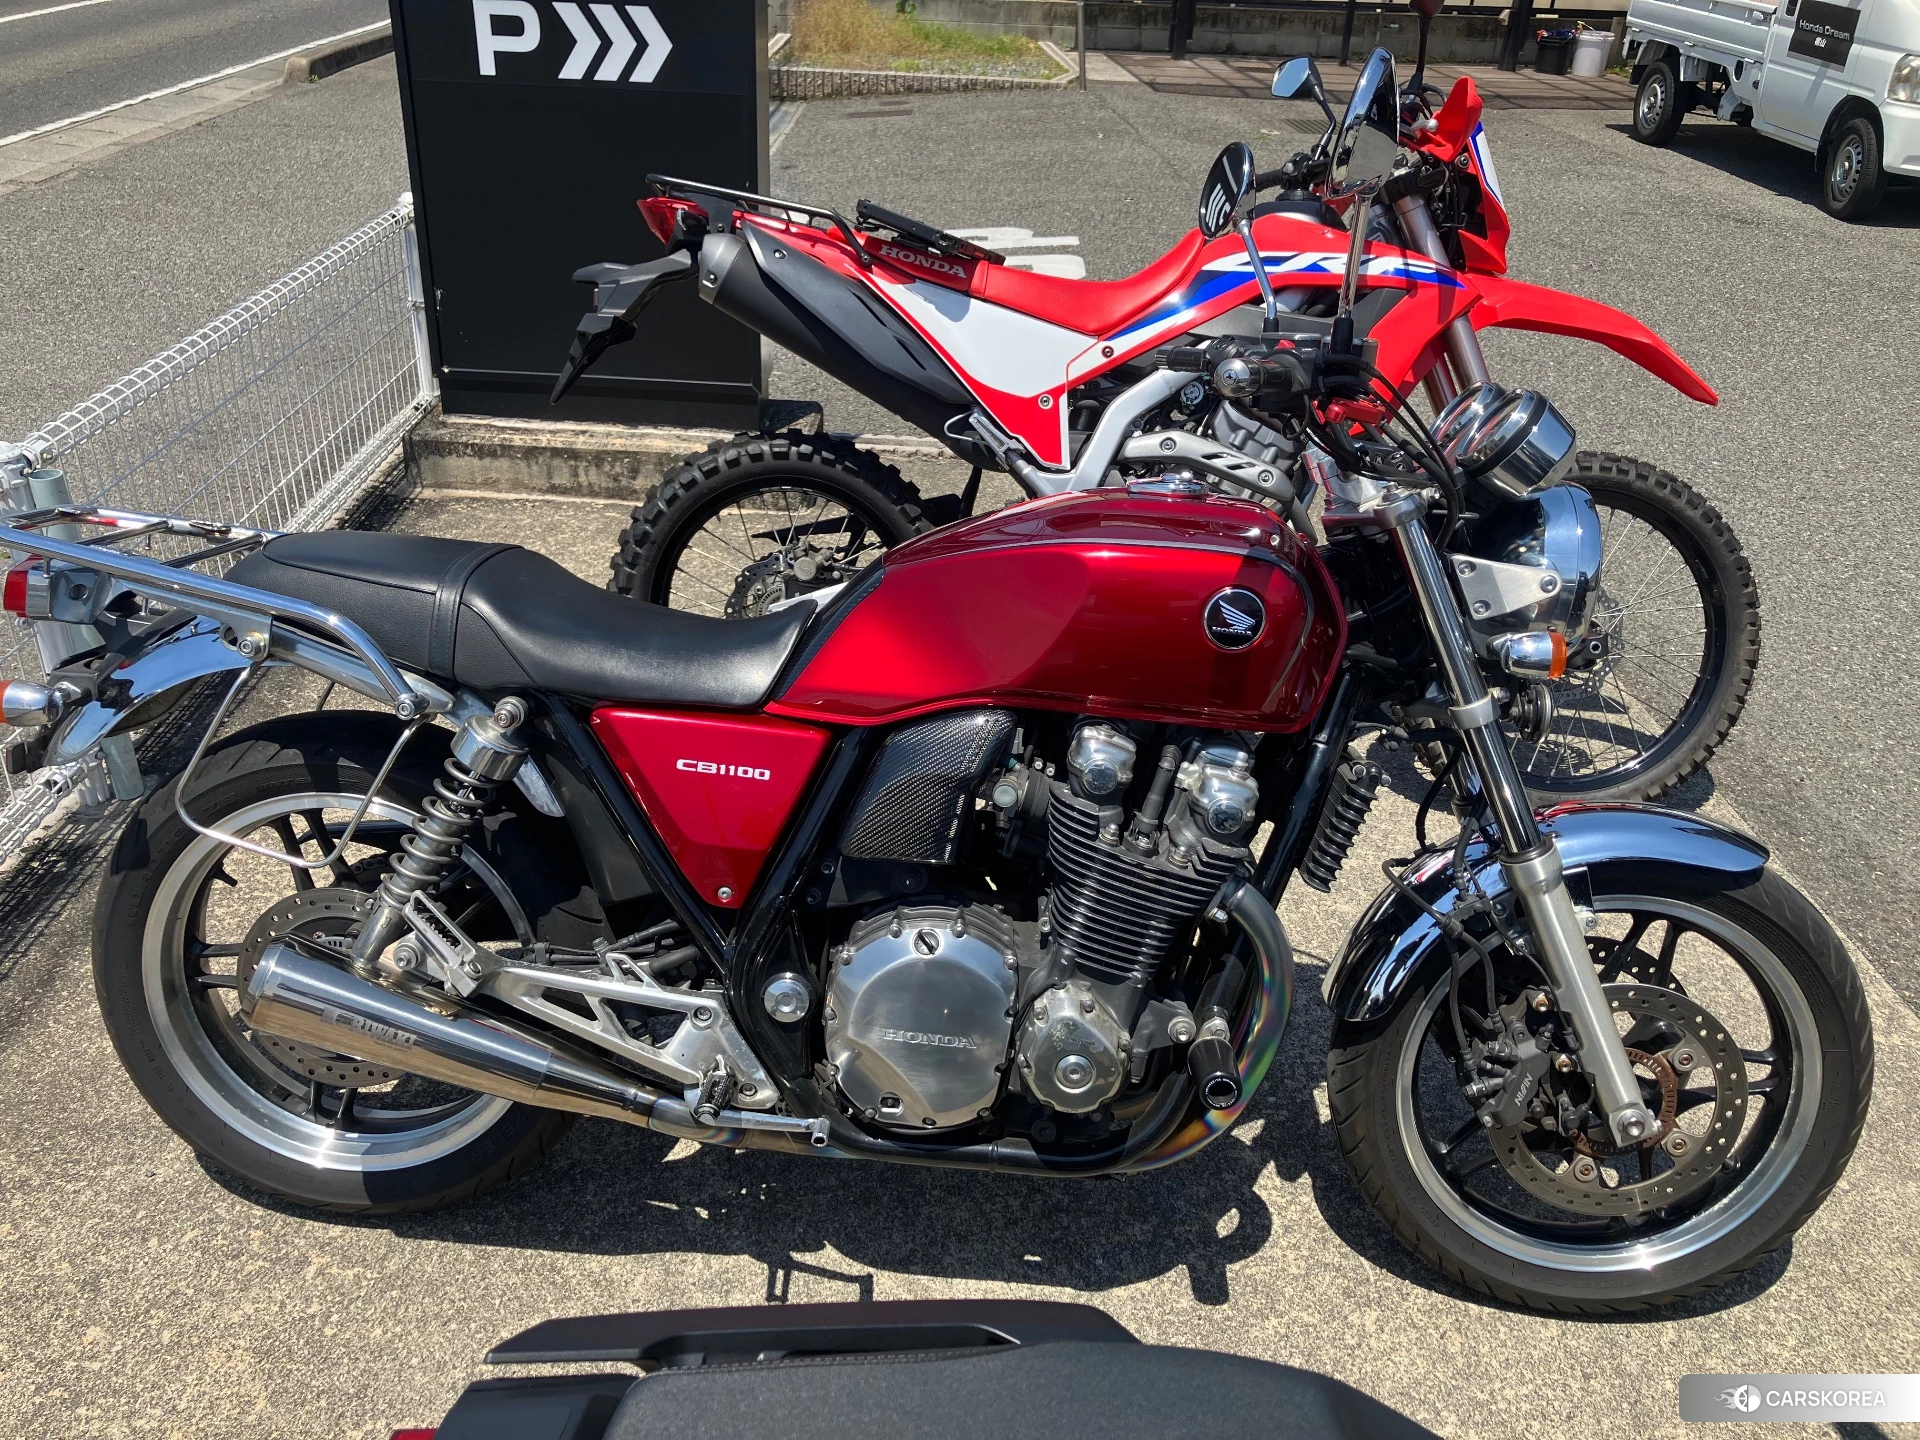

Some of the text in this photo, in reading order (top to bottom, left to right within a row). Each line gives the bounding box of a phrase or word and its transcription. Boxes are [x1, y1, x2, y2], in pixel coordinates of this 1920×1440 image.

[472, 0, 541, 76] P
[1799, 19, 1850, 40] Honda Dream
[879, 244, 967, 279] HONDA
[1212, 626, 1253, 637] HONDA
[676, 758, 771, 781] CB1100
[883, 1028, 977, 1049] HONDA
